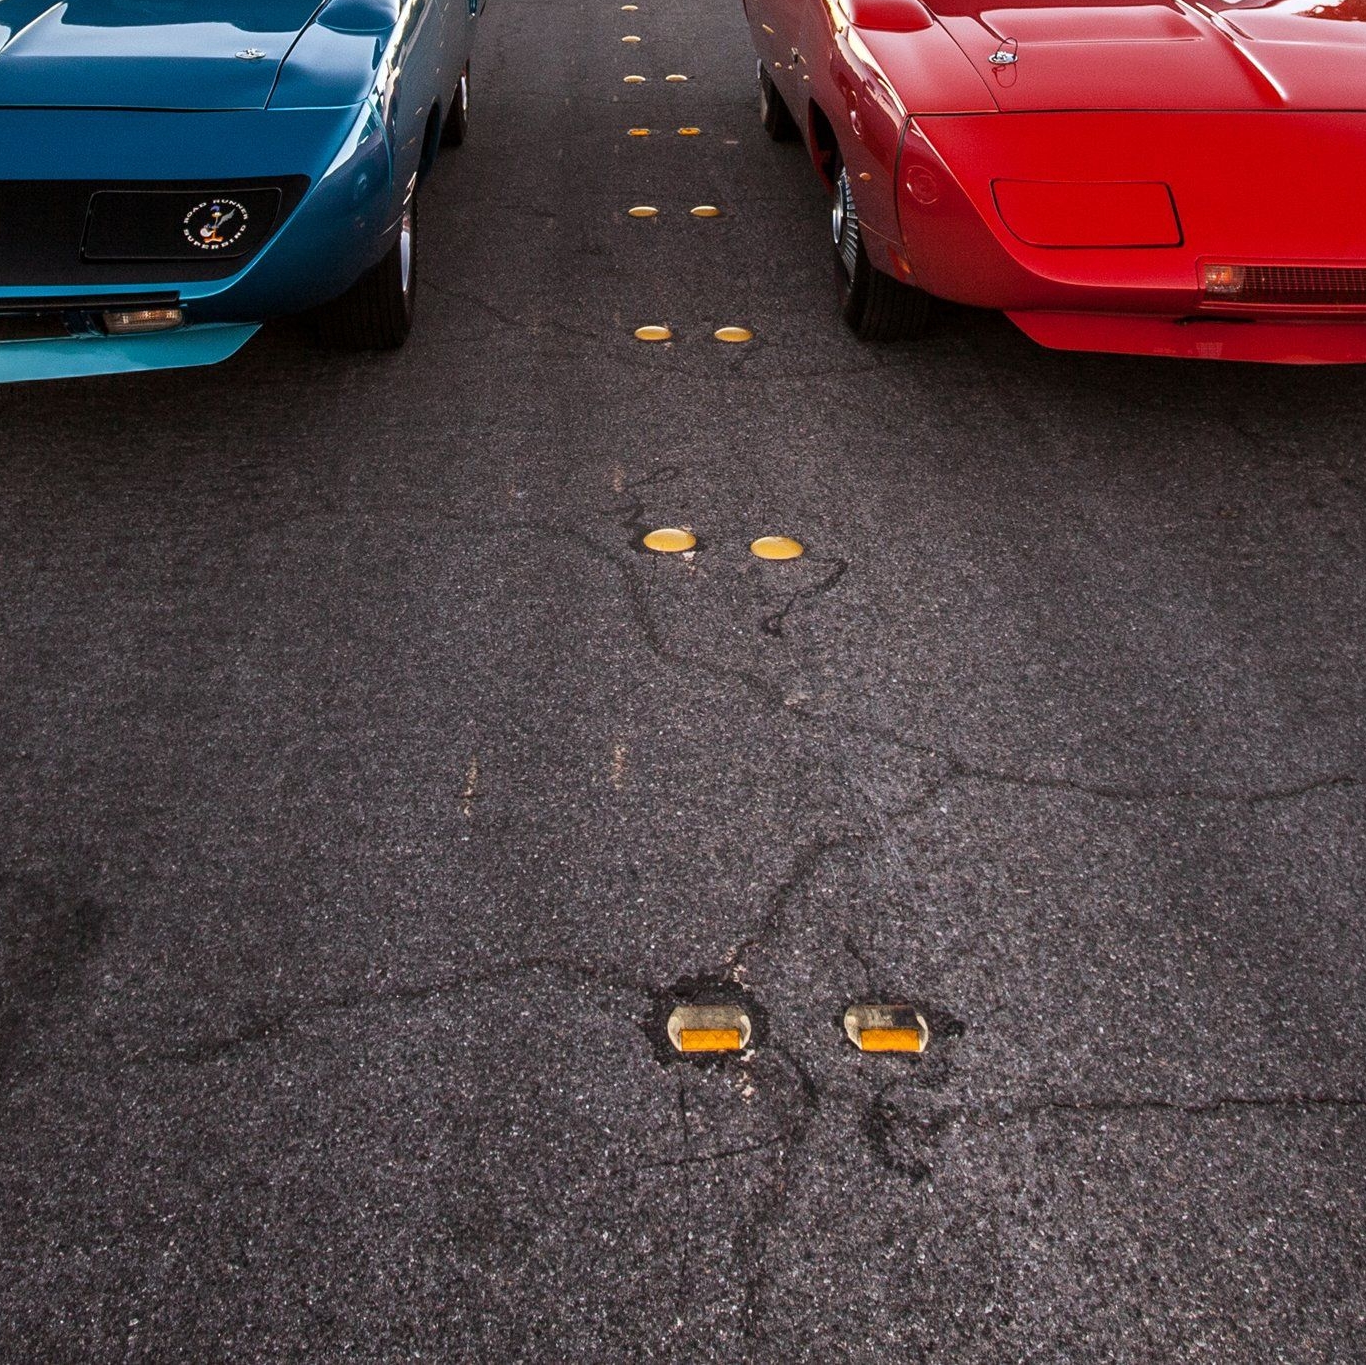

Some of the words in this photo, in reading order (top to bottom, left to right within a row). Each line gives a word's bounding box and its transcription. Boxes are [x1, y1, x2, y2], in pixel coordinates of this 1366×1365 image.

[183, 202, 207, 224] ROAD
[213, 199, 248, 220] RUNNER
[183, 225, 246, 250] SUPERBIRD
